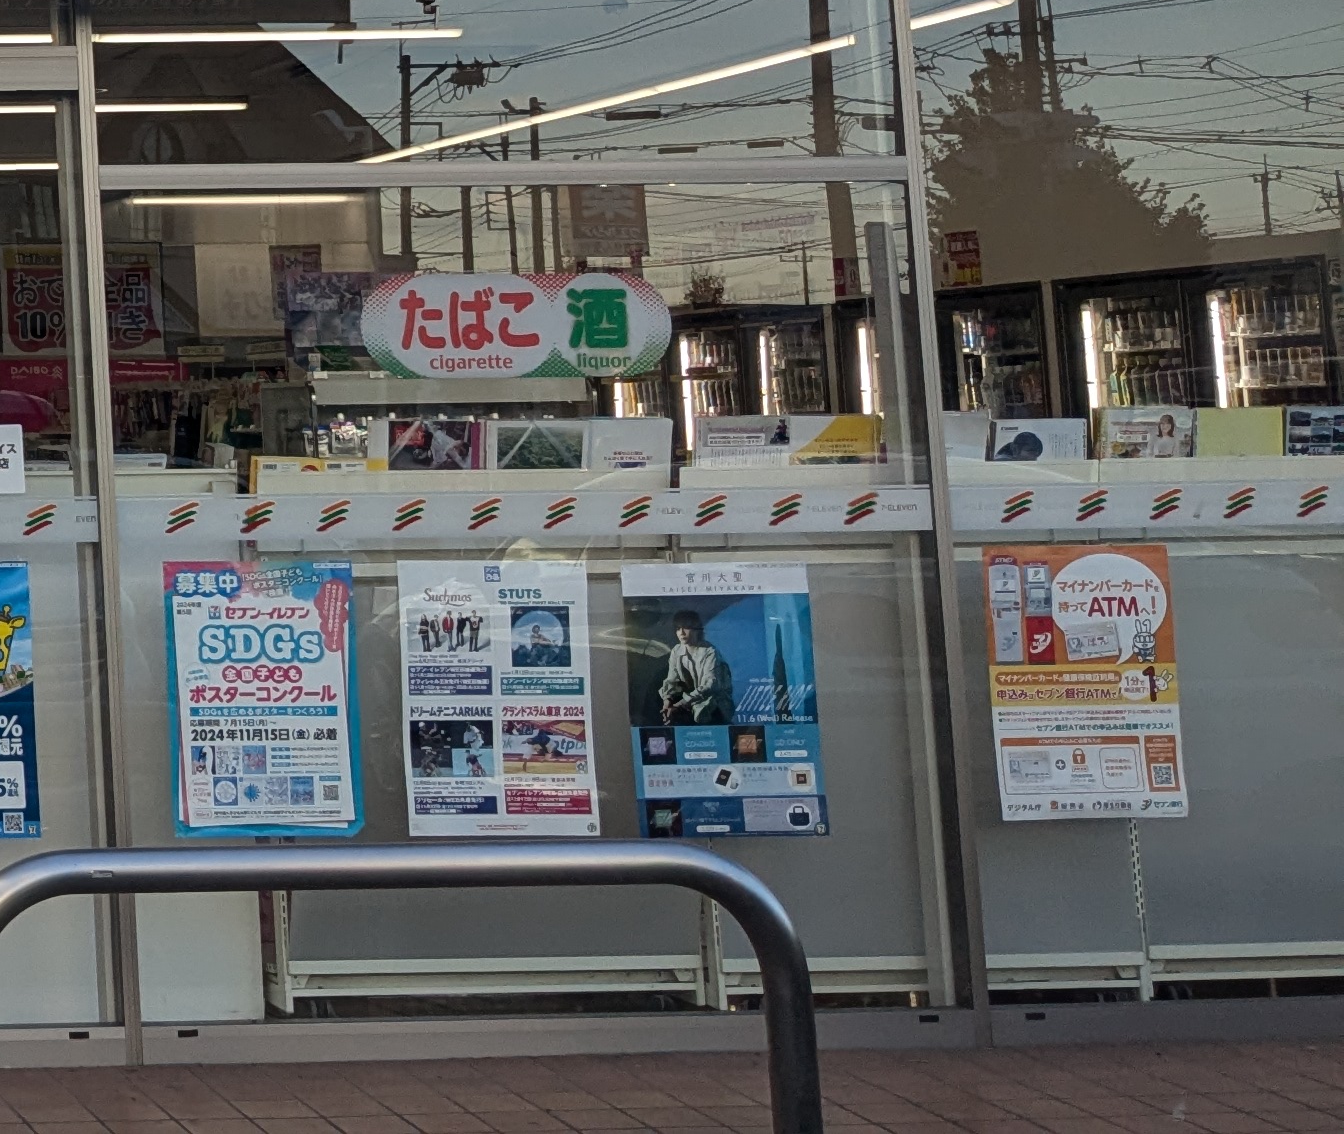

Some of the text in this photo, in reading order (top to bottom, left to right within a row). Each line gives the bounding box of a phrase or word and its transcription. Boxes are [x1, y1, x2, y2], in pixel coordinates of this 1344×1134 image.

[399, 286, 629, 350] たばこ 酒
[429, 351, 632, 372] cigarette liquor
[175, 572, 238, 594] 募集中
[1056, 579, 1160, 593] マイナンバーカードを
[498, 588, 542, 599] STUTS
[1058, 596, 1157, 617] 持ってATMへ！
[200, 624, 323, 663] SDGs
[223, 666, 302, 683] 全国子ども
[189, 684, 337, 704] ポスターコンクール
[410, 706, 493, 718] ドリームテニスARIAKE
[563, 706, 585, 716] 2024
[781, 713, 814, 722] Release
